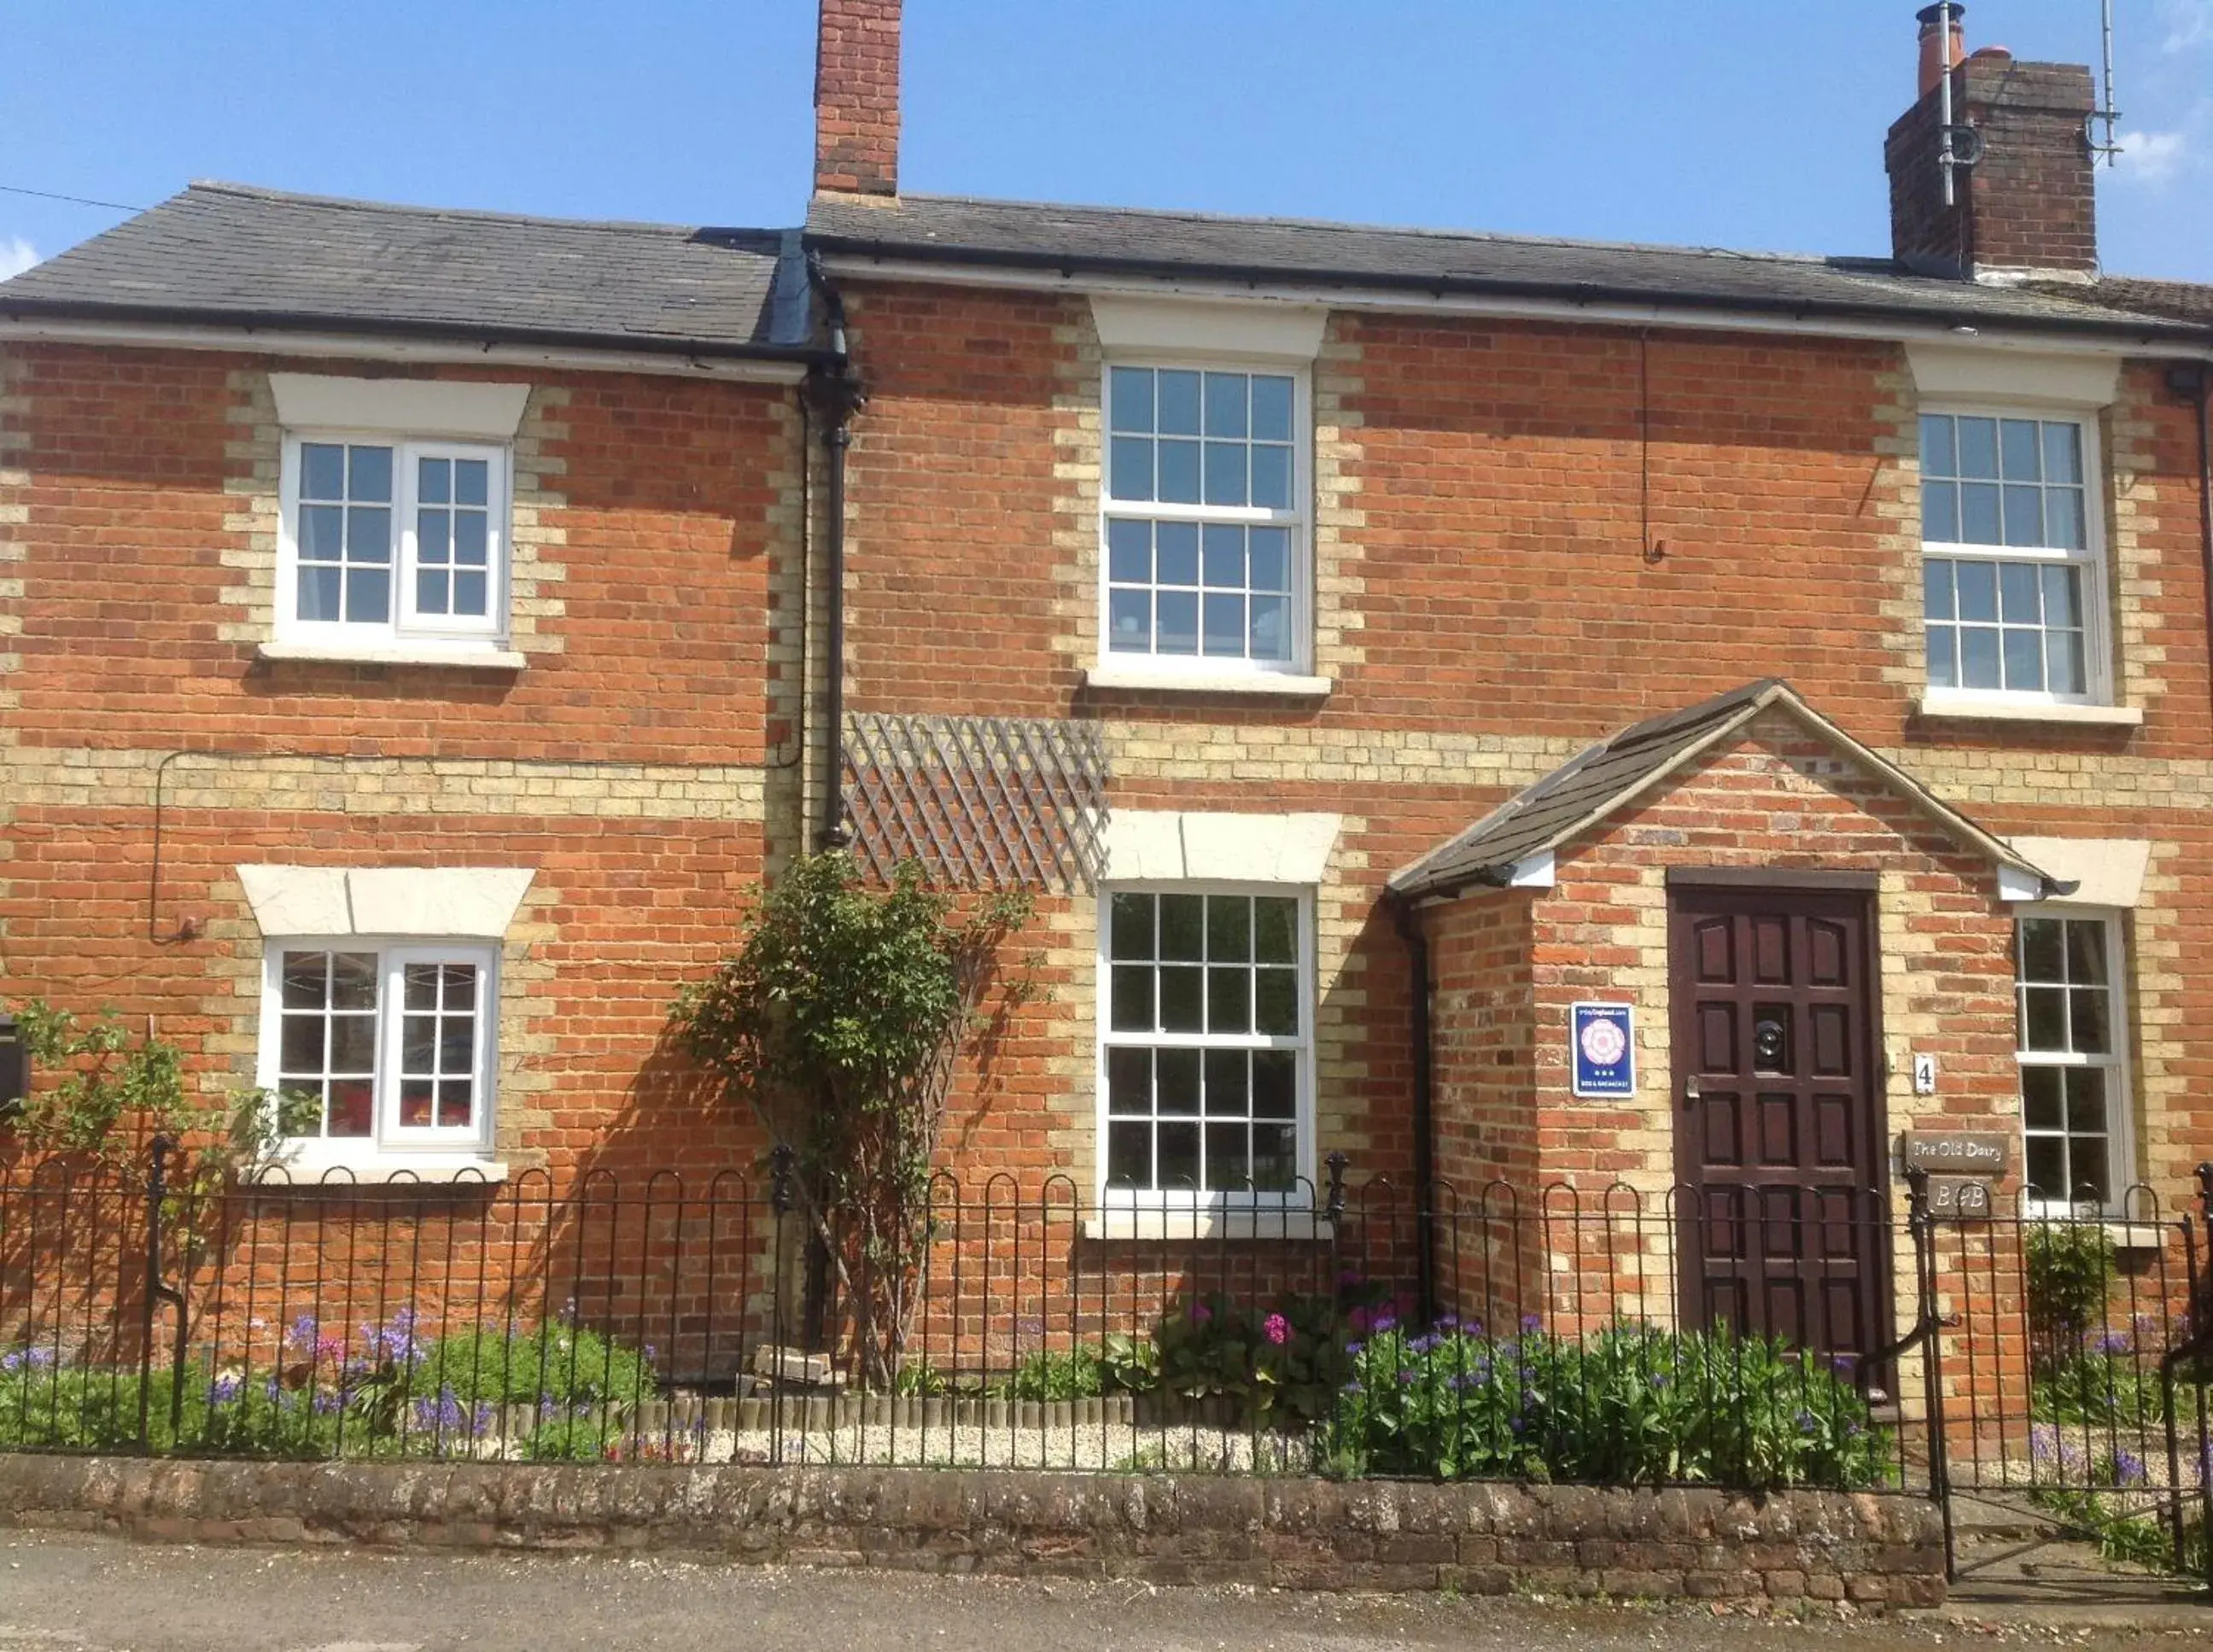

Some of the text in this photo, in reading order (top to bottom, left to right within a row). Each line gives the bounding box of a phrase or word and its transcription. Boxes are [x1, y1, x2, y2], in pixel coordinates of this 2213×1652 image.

[1918, 1063, 1932, 1084] 4
[1913, 1141, 2001, 1161] The Old Dairy
